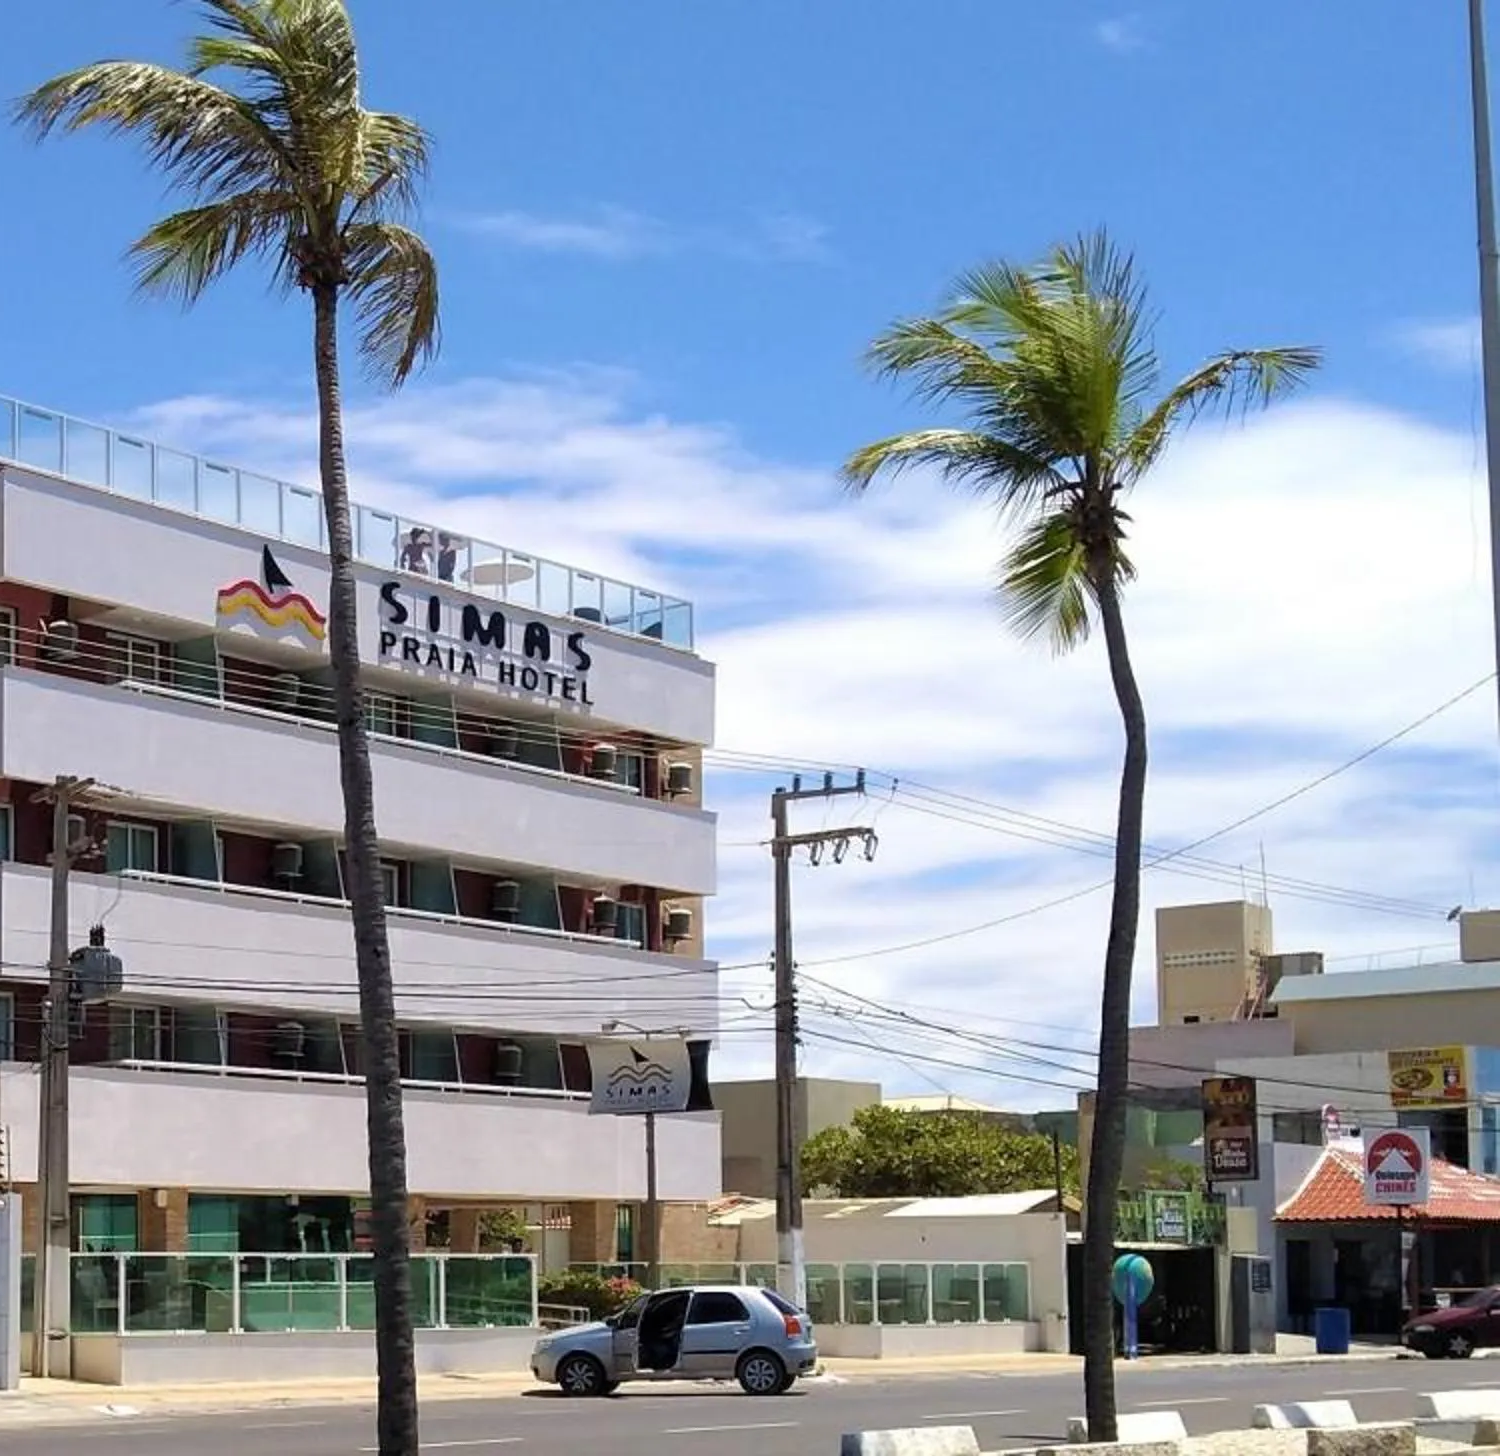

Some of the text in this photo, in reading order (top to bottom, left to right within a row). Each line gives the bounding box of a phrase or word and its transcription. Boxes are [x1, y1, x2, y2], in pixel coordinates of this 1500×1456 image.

[380, 582, 591, 671] SIMAS
[380, 631, 594, 706] PRAIA HOTEL
[605, 1085, 672, 1099] SIMAS
